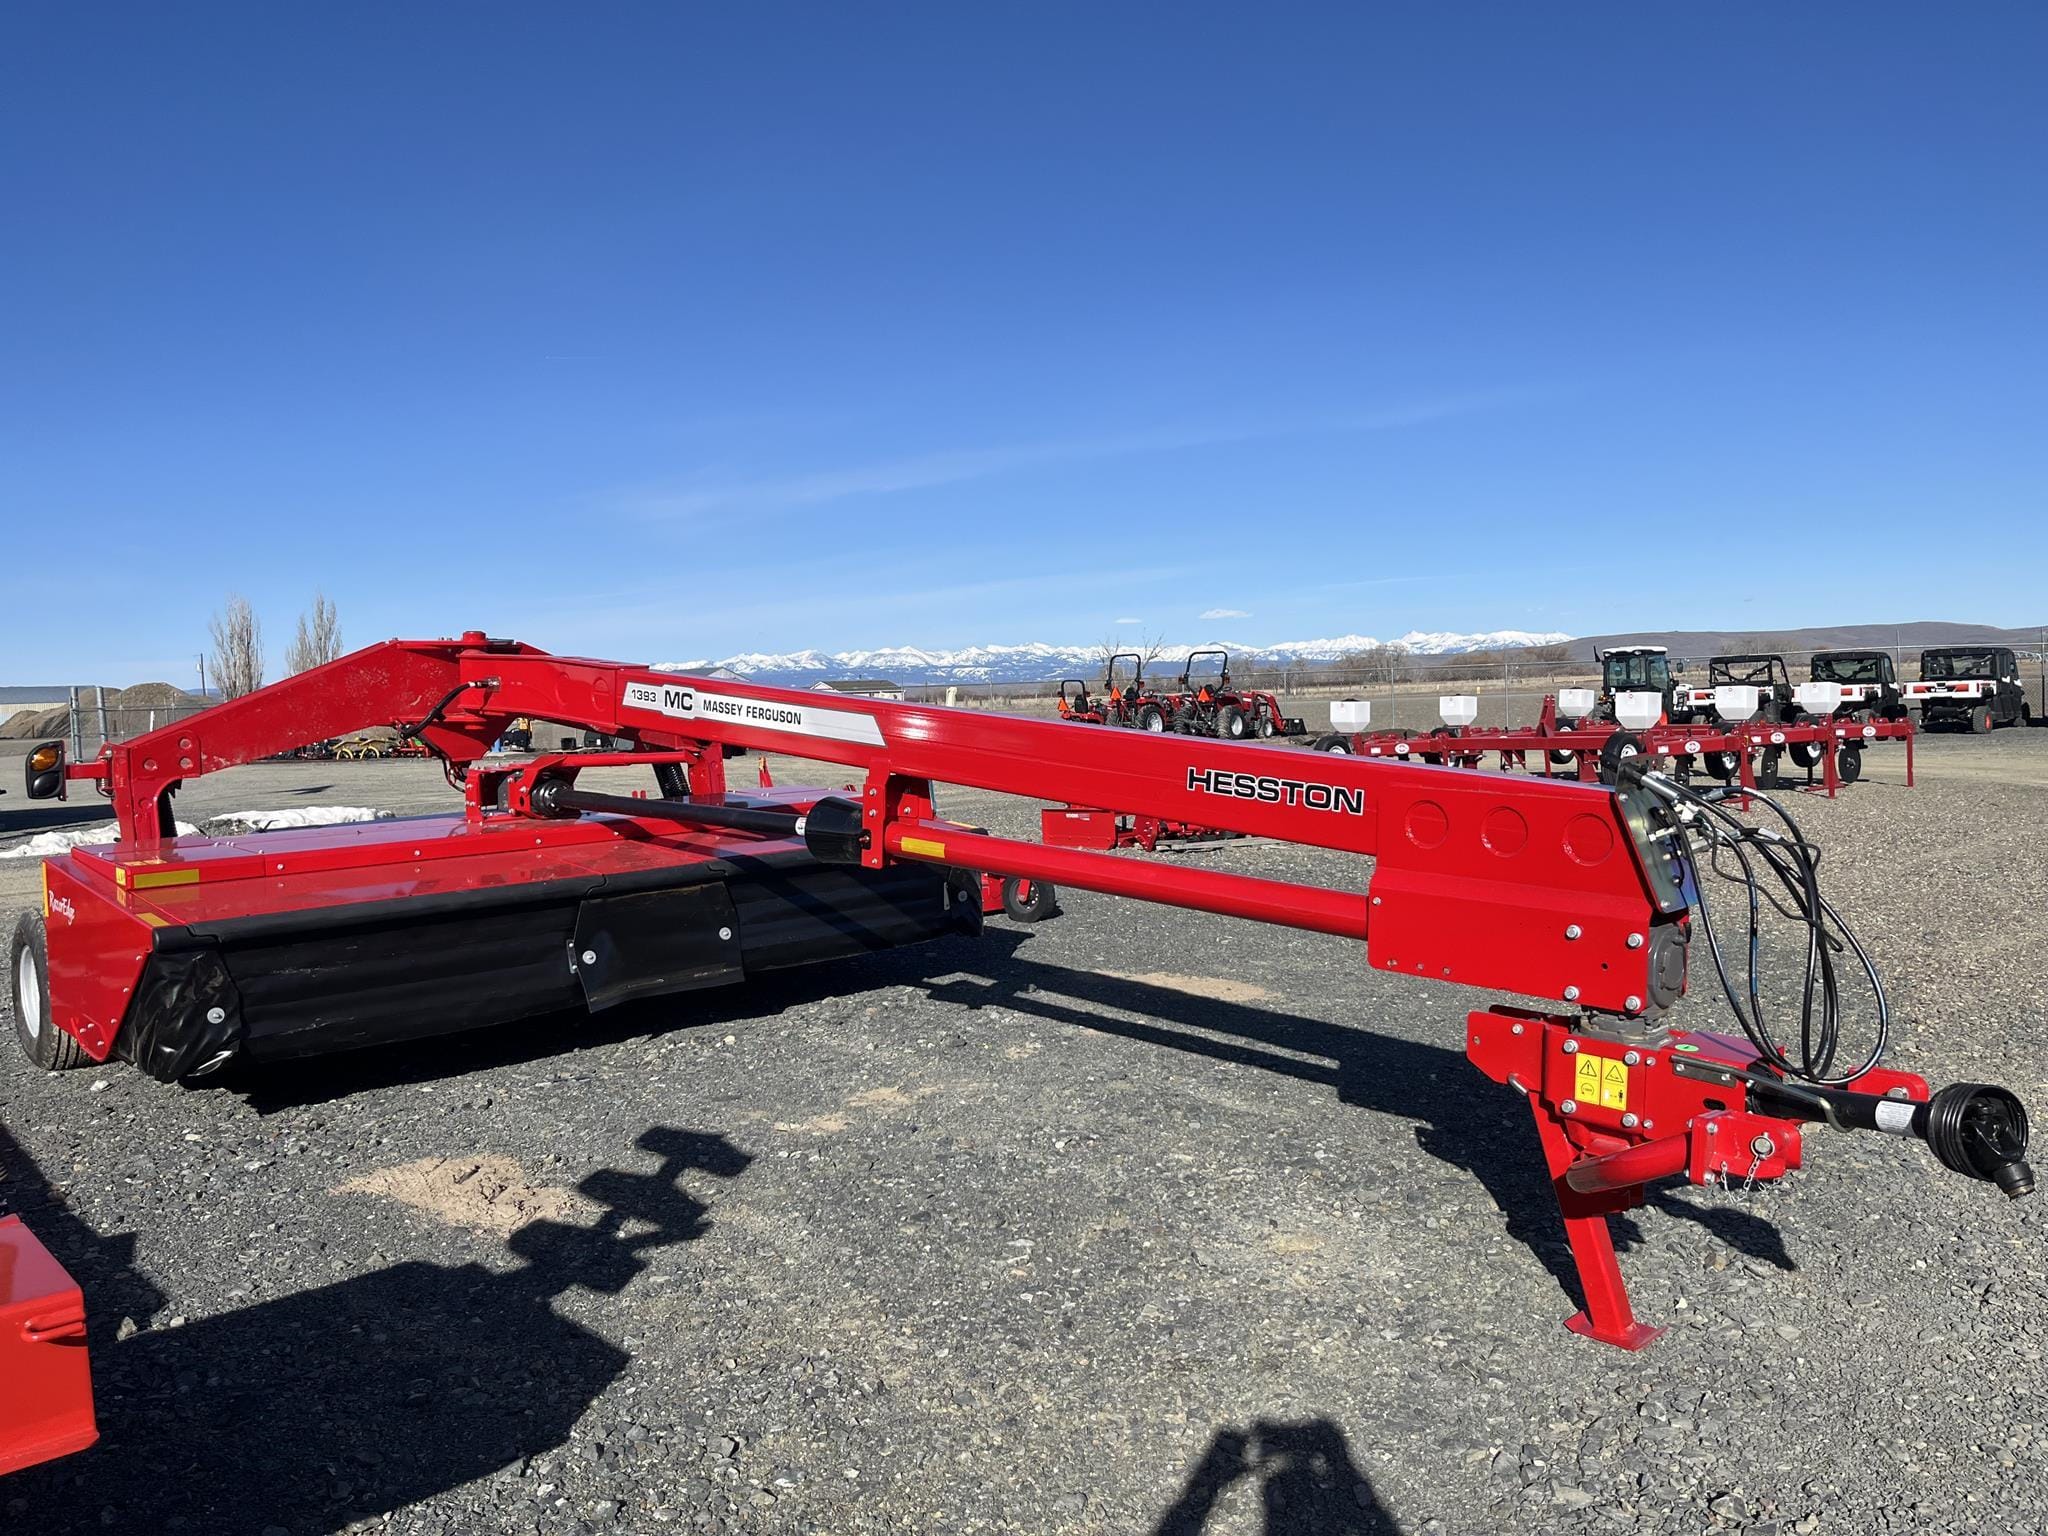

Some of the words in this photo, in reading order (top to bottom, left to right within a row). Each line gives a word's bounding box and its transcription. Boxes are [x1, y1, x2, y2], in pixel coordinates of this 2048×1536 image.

[631, 689, 657, 703] 1393
[664, 690, 693, 711] MC
[703, 699, 743, 717] MASSEY
[746, 706, 802, 725] FERGUSON
[1187, 767, 1364, 816] HESSTON
